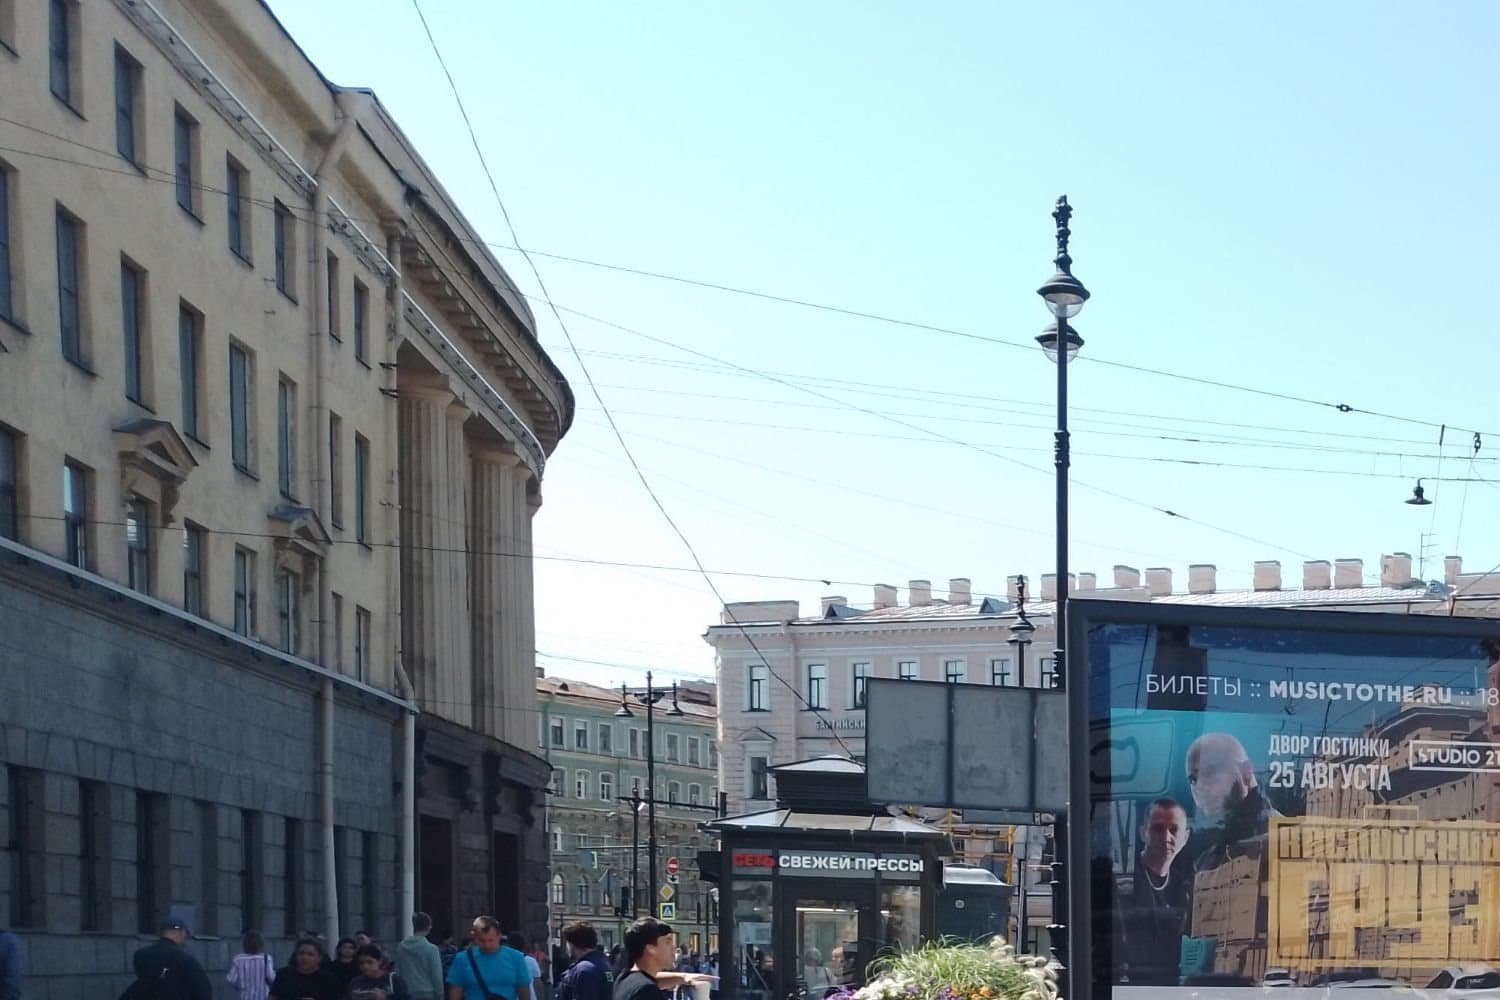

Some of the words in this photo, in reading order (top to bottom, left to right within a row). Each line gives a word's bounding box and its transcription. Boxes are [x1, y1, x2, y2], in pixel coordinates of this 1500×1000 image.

[1146, 674, 1241, 697] БИЛЕТЫ
[1269, 680, 1452, 704] MUSICTOTHE.RU
[1268, 734, 1310, 756] ДВОР
[1312, 737, 1390, 757] ГОСТИНКИ
[1417, 748, 1480, 765] STUDIO
[1486, 750, 1500, 765] 21
[1269, 761, 1295, 789] 25
[1301, 763, 1392, 791] АВГУСТА
[779, 855, 850, 870] СВЕЖЕЙ
[854, 858, 924, 873] ПРЕССЫ
